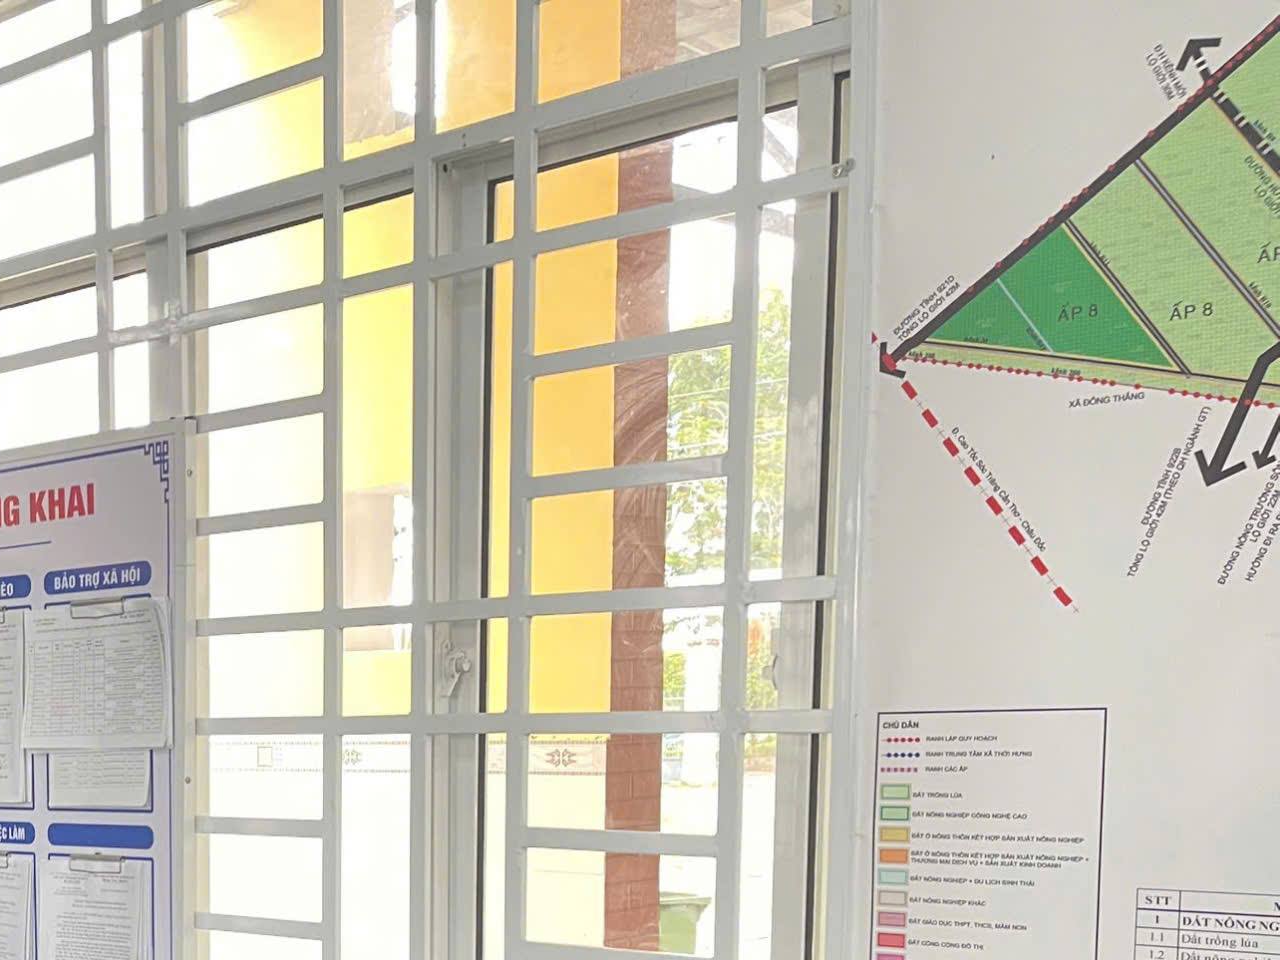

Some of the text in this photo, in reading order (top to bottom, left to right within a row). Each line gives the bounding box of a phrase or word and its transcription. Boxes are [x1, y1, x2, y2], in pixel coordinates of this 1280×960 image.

[1058, 302, 1098, 322] ẤP 8
[1170, 301, 1213, 321] ẤP 8
[1069, 397, 1080, 408] XÃ
[29, 483, 96, 524] KHAI
[54, 567, 140, 590] BẢO TRỢ XÃ HỘI
[9, 825, 25, 840] LÀM
[1145, 896, 1171, 905] STT
[1182, 915, 1212, 927] ĐẤT
[1214, 917, 1256, 930] NÔNG
[1150, 932, 1258, 948] 1.1 Đất trồng lúa
[1149, 950, 1165, 960] 1.2
